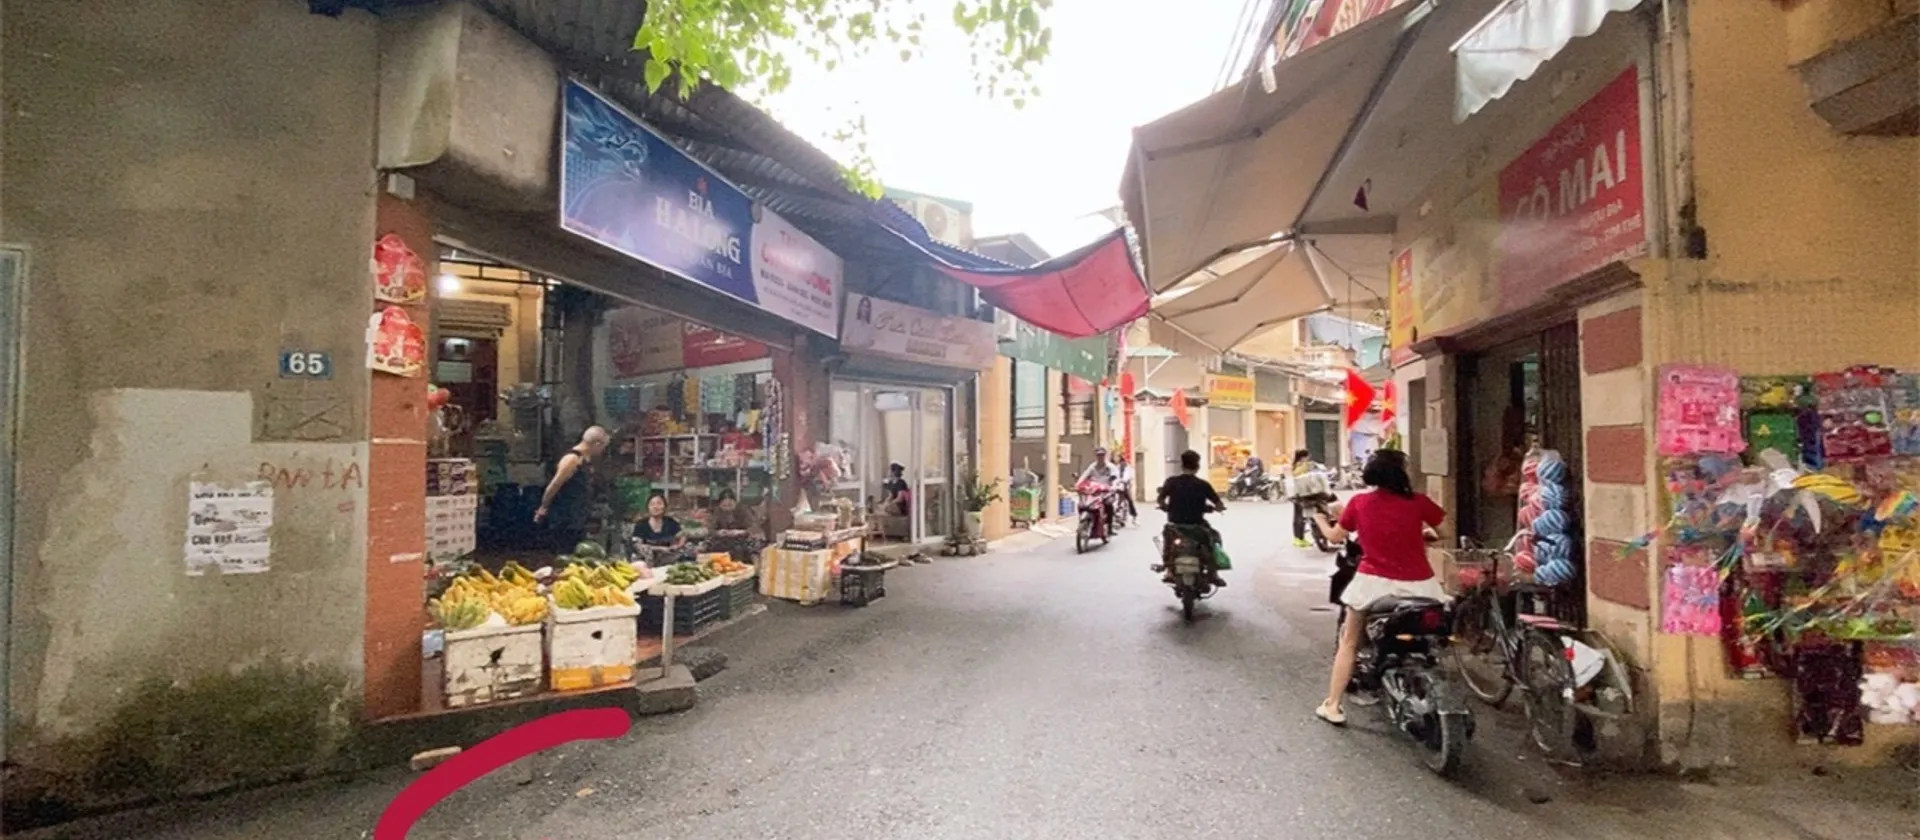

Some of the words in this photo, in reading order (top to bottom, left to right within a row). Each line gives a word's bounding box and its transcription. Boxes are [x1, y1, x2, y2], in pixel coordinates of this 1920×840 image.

[1559, 128, 1627, 217] MAI
[688, 189, 715, 220] BIA
[289, 351, 323, 375] 65
